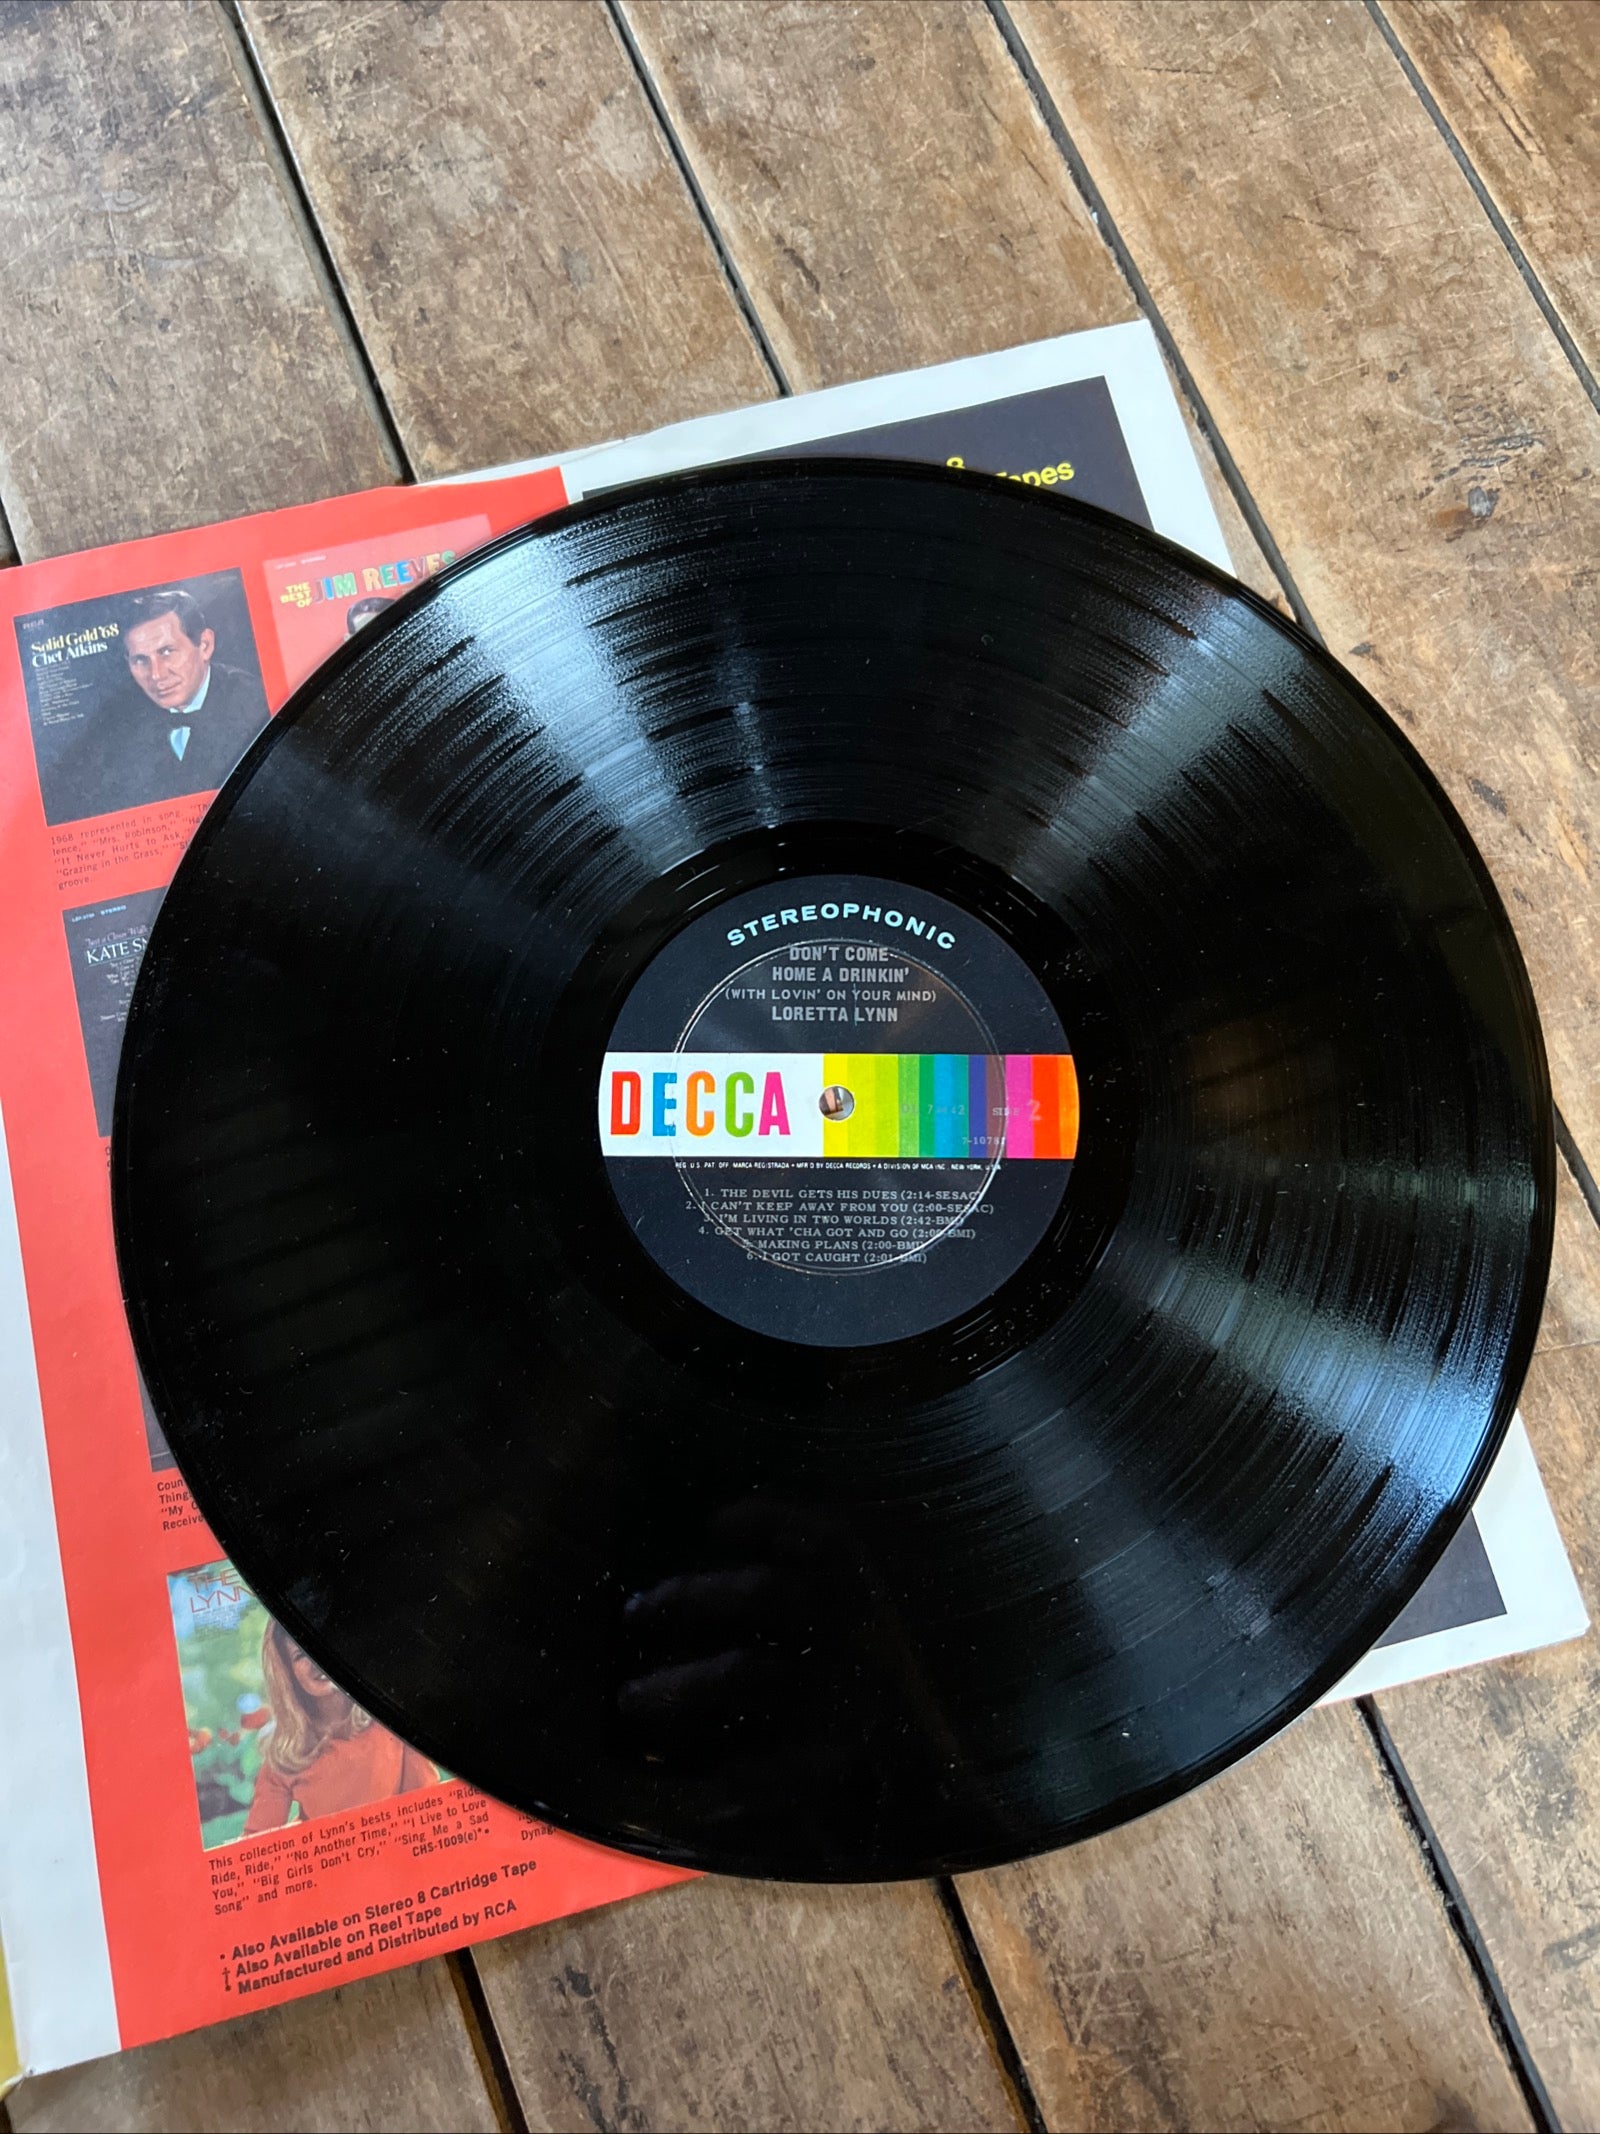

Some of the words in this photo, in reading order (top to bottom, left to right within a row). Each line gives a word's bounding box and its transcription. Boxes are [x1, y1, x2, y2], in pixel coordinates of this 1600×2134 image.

[280, 591, 311, 604] BEST
[286, 582, 311, 594] THE
[313, 573, 358, 604] JIM
[297, 598, 311, 608] OF
[31, 636, 65, 653] Solid
[65, 627, 99, 647] Gold
[32, 651, 63, 668] Chet
[65, 641, 108, 662] Atkins
[51, 833, 74, 846] 1968
[80, 819, 137, 840] represented
[143, 815, 152, 824] in
[77, 850, 105, 863] Never
[112, 842, 140, 855] Hurts
[147, 838, 157, 846] to
[102, 859, 111, 869] in
[114, 854, 130, 866] the
[726, 902, 957, 950] STEREOPHONIC
[86, 941, 130, 964] KATE
[789, 946, 840, 962] DON'T
[844, 946, 889, 962] COME
[771, 966, 817, 982] HOME
[822, 967, 833, 982] A
[839, 966, 910, 984] DRINKIN'
[724, 987, 766, 1001] (WITH
[771, 988, 822, 1001] LOVIN'
[826, 989, 847, 1001] ON
[853, 988, 892, 1002] YOUR
[896, 989, 937, 1003] MIND)
[771, 1005, 849, 1022] LORETTA
[854, 1006, 898, 1023] LYNN
[610, 1070, 791, 1138] DECCA
[1025, 1099, 1043, 1122] 2
[825, 1162, 844, 1170] DECCA
[845, 1162, 871, 1170] RECORDS
[704, 1188, 715, 1197] 1.
[720, 1188, 748, 1198] THE
[752, 1188, 794, 1199] DEVIL
[798, 1189, 834, 1199] GETS
[836, 1189, 859, 1199] HIS
[862, 1189, 898, 1200] DUES
[685, 1201, 697, 1210] 2.
[710, 1201, 752, 1211] CAN'T
[756, 1202, 793, 1211] KEEP
[799, 1202, 836, 1212] AWAY
[840, 1203, 877, 1213] FROM
[880, 1203, 909, 1213] YOU
[719, 1213, 738, 1223] I'M
[743, 1214, 789, 1224] LIVING
[793, 1214, 808, 1224] IN
[812, 1215, 839, 1225] TWO
[843, 1215, 898, 1225] WORLDS
[698, 1226, 709, 1235] 4.
[746, 1227, 785, 1237] WHAT
[788, 1227, 822, 1237] 'CHA
[826, 1227, 853, 1237] GOT
[857, 1228, 886, 1238] AND
[889, 1228, 909, 1238] GO
[757, 1239, 811, 1250] MAKING
[814, 1240, 859, 1250] PLANS
[746, 1251, 758, 1261] 6.
[772, 1252, 803, 1262] GOT
[805, 1252, 861, 1263] CAUGHT
[186, 1567, 241, 1594] THE
[208, 1855, 233, 1871] This
[239, 1838, 295, 1863] collection
[301, 1831, 314, 1844] of
[319, 1820, 356, 1841] Lynn's
[360, 1809, 392, 1827] bests
[396, 1796, 444, 1817] includes
[210, 1869, 241, 1887] Ride,
[313, 1836, 356, 1857] Another
[420, 1811, 443, 1827] Live
[446, 1806, 458, 1817] to
[462, 1799, 487, 1814] Love
[287, 1862, 314, 1880] Girls
[320, 1851, 351, 1870] Don't
[432, 1824, 448, 1837] Me
[456, 1820, 463, 1830] a
[469, 1810, 490, 1826] Sad
[257, 1887, 279, 1903] and
[285, 1879, 318, 1896] more.
[231, 1940, 265, 1961] Also
[269, 1918, 339, 1950] Available
[342, 1911, 362, 1927] on
[364, 1896, 414, 1921] Stereo
[417, 1890, 427, 1905] 8
[430, 1871, 498, 1900] Cartridge
[501, 1860, 537, 1880] Tape
[235, 1957, 270, 1979] Also
[273, 1935, 343, 1968] Available
[345, 1929, 366, 1944] on
[368, 1915, 403, 1937] Reel
[405, 1905, 443, 1926] Tape
[237, 1952, 343, 1995] Manufactured
[346, 1943, 375, 1962] and
[377, 1917, 460, 1953] Distributed
[462, 1910, 480, 1927] by
[483, 1898, 518, 1921] RCA
